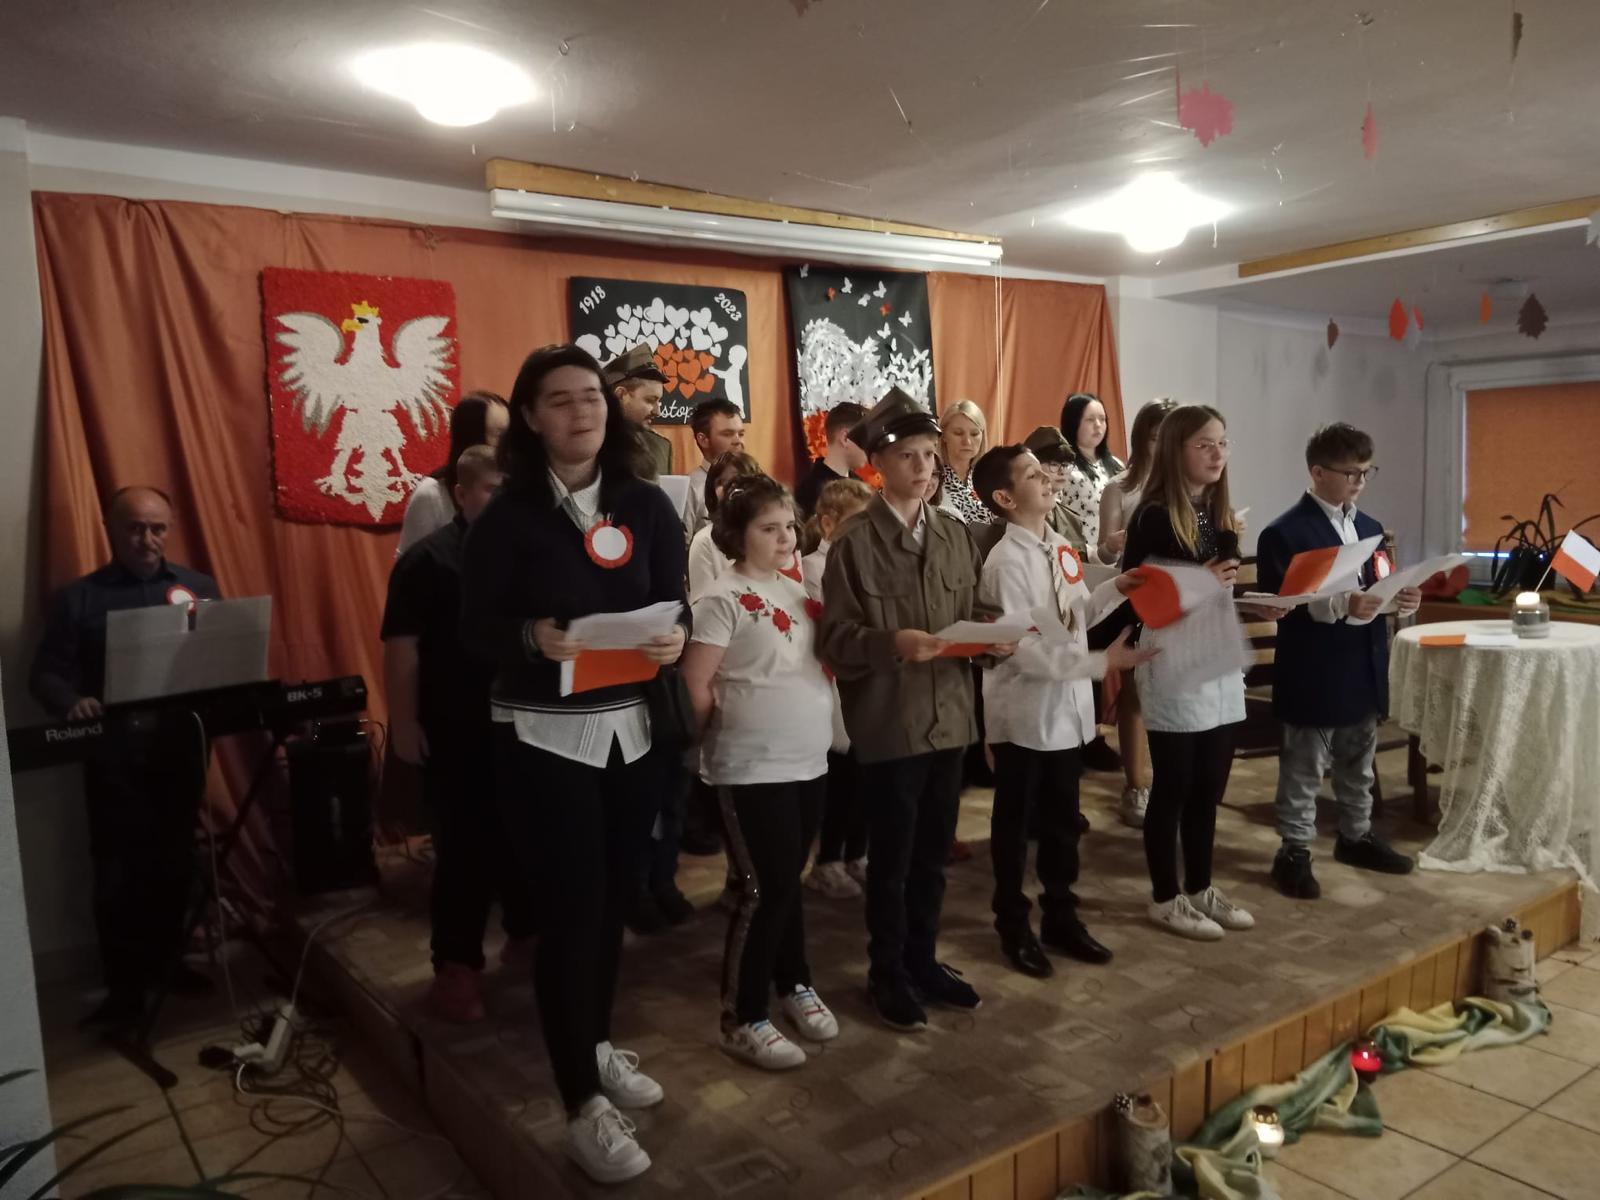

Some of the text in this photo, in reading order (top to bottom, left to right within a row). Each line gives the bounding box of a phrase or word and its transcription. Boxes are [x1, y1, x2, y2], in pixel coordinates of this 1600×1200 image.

[578, 285, 606, 315] 1918
[714, 292, 742, 321] 2023
[656, 400, 693, 424] istop
[287, 688, 323, 703] BK-5
[44, 721, 104, 742] Roland
